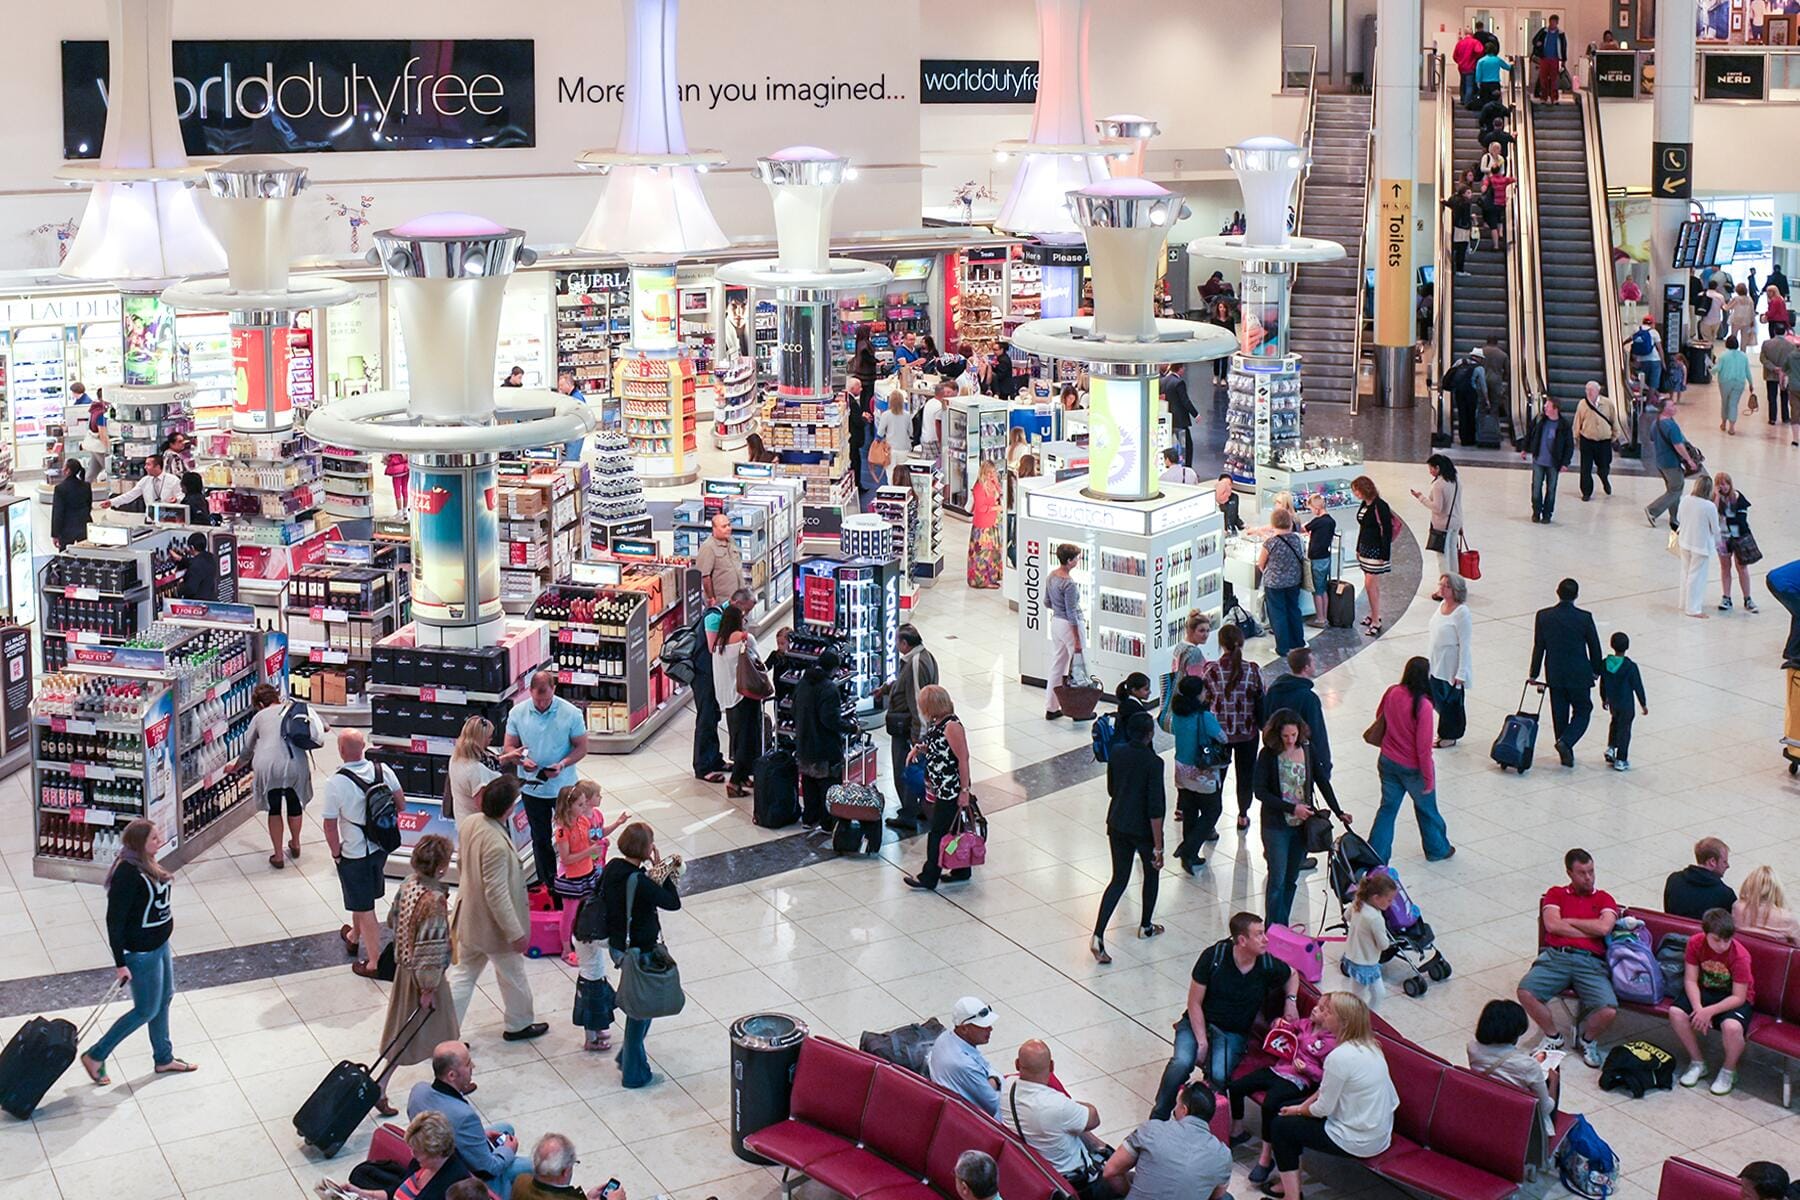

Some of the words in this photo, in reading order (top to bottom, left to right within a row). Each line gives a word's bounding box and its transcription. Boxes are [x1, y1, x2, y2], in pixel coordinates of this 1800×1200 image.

[97, 56, 505, 134] orlddutyfree
[557, 75, 626, 103] More
[682, 83, 700, 103] an
[709, 83, 757, 109] you
[766, 73, 906, 109] imagined...
[924, 66, 1039, 98] worlddutyfre
[1599, 74, 1631, 82] NERO
[1717, 75, 1751, 84] NERO
[1053, 253, 1083, 262] Please
[1389, 214, 1405, 267] Toilets
[1047, 503, 1114, 526] swatch
[1024, 555, 1040, 630] swatch
[1153, 572, 1163, 650] swatch
[886, 576, 897, 685] SEKONDA
[399, 819, 417, 829] £44
